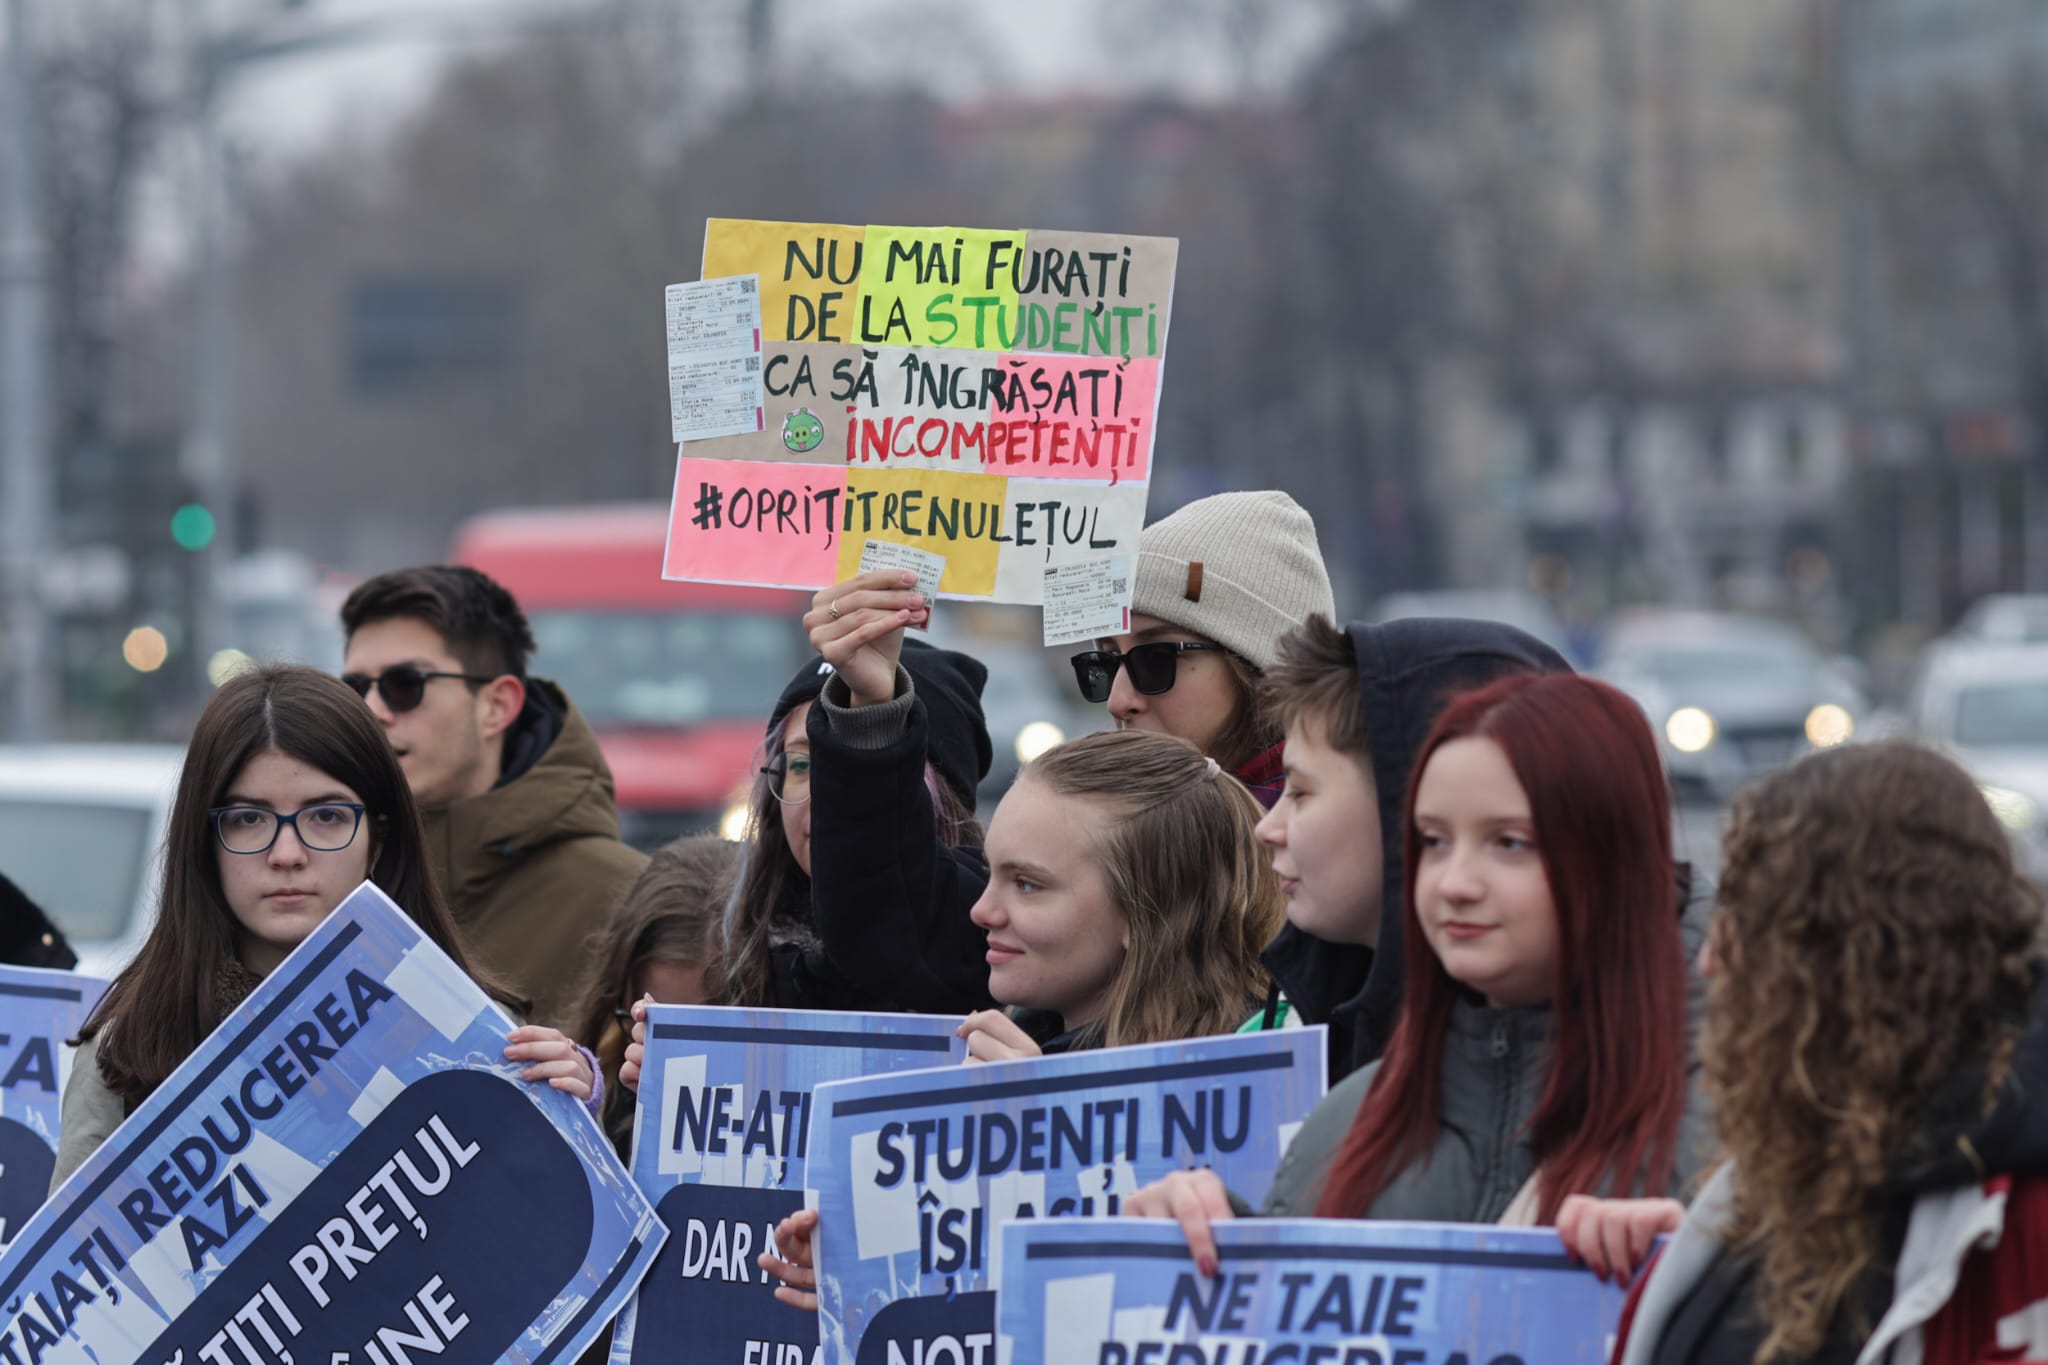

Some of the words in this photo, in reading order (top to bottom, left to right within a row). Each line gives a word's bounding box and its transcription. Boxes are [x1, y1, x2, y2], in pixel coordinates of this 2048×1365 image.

[784, 237, 863, 285] NU
[787, 292, 843, 342] DE
[861, 295, 912, 342] LA
[764, 354, 816, 397] CA
[830, 349, 879, 407] SĂ
[118, 968, 394, 1244] REDUCEREA
[874, 1098, 1139, 1190] STUDENȚI
[1162, 1086, 1251, 1158] NU
[175, 1162, 270, 1273] AZI
[289, 1114, 481, 1309] PREȚUL
[682, 1218, 752, 1283] DAR
[917, 1189, 983, 1302] ÎȘI
[1163, 1272, 1260, 1332] NE
[1277, 1273, 1425, 1336] TAIE
